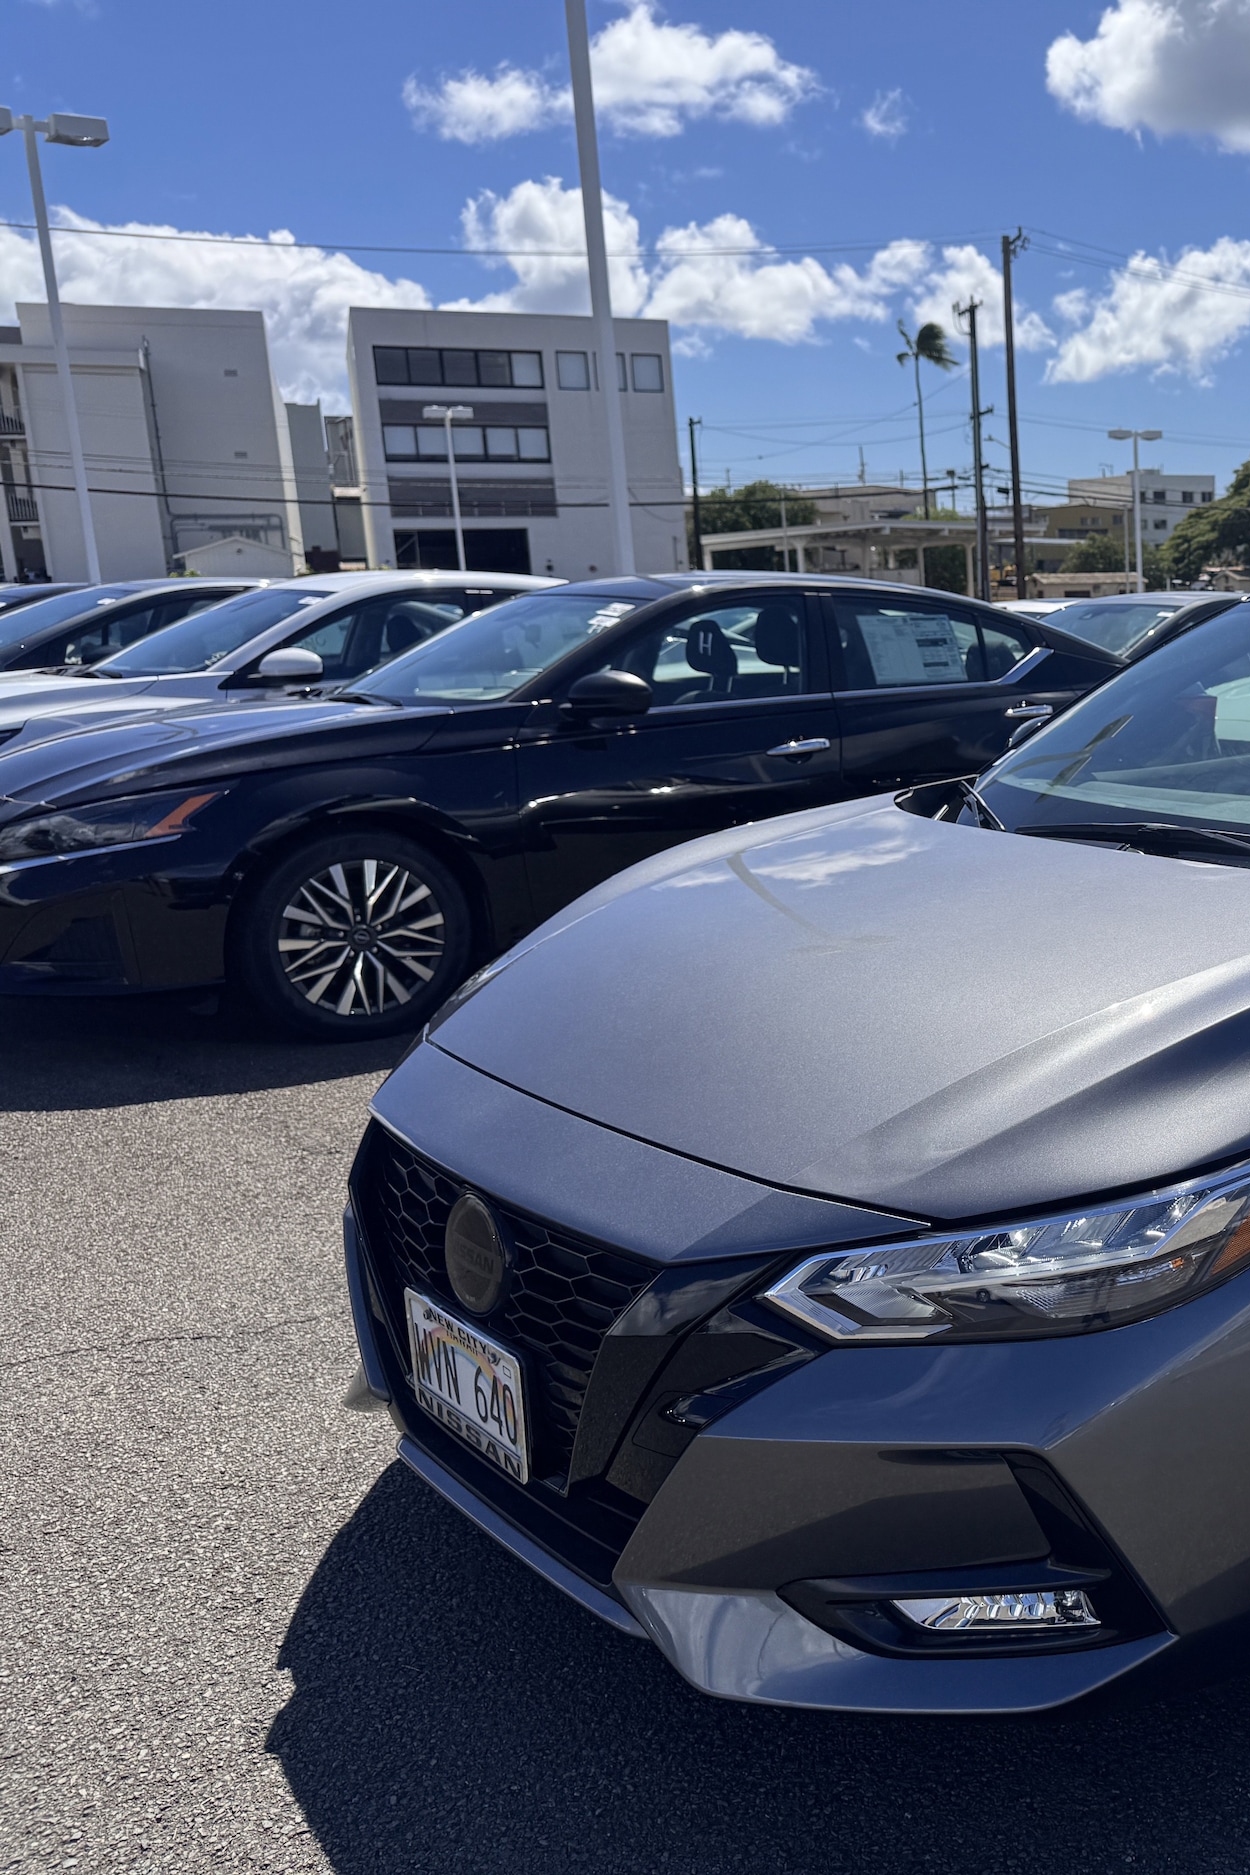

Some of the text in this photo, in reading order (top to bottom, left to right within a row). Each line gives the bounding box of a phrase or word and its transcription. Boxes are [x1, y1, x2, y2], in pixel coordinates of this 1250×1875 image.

[428, 1307, 454, 1332] NEW
[457, 1327, 487, 1354] CITY
[414, 1322, 518, 1446] WVN 640
[417, 1387, 521, 1480] NISSAN
